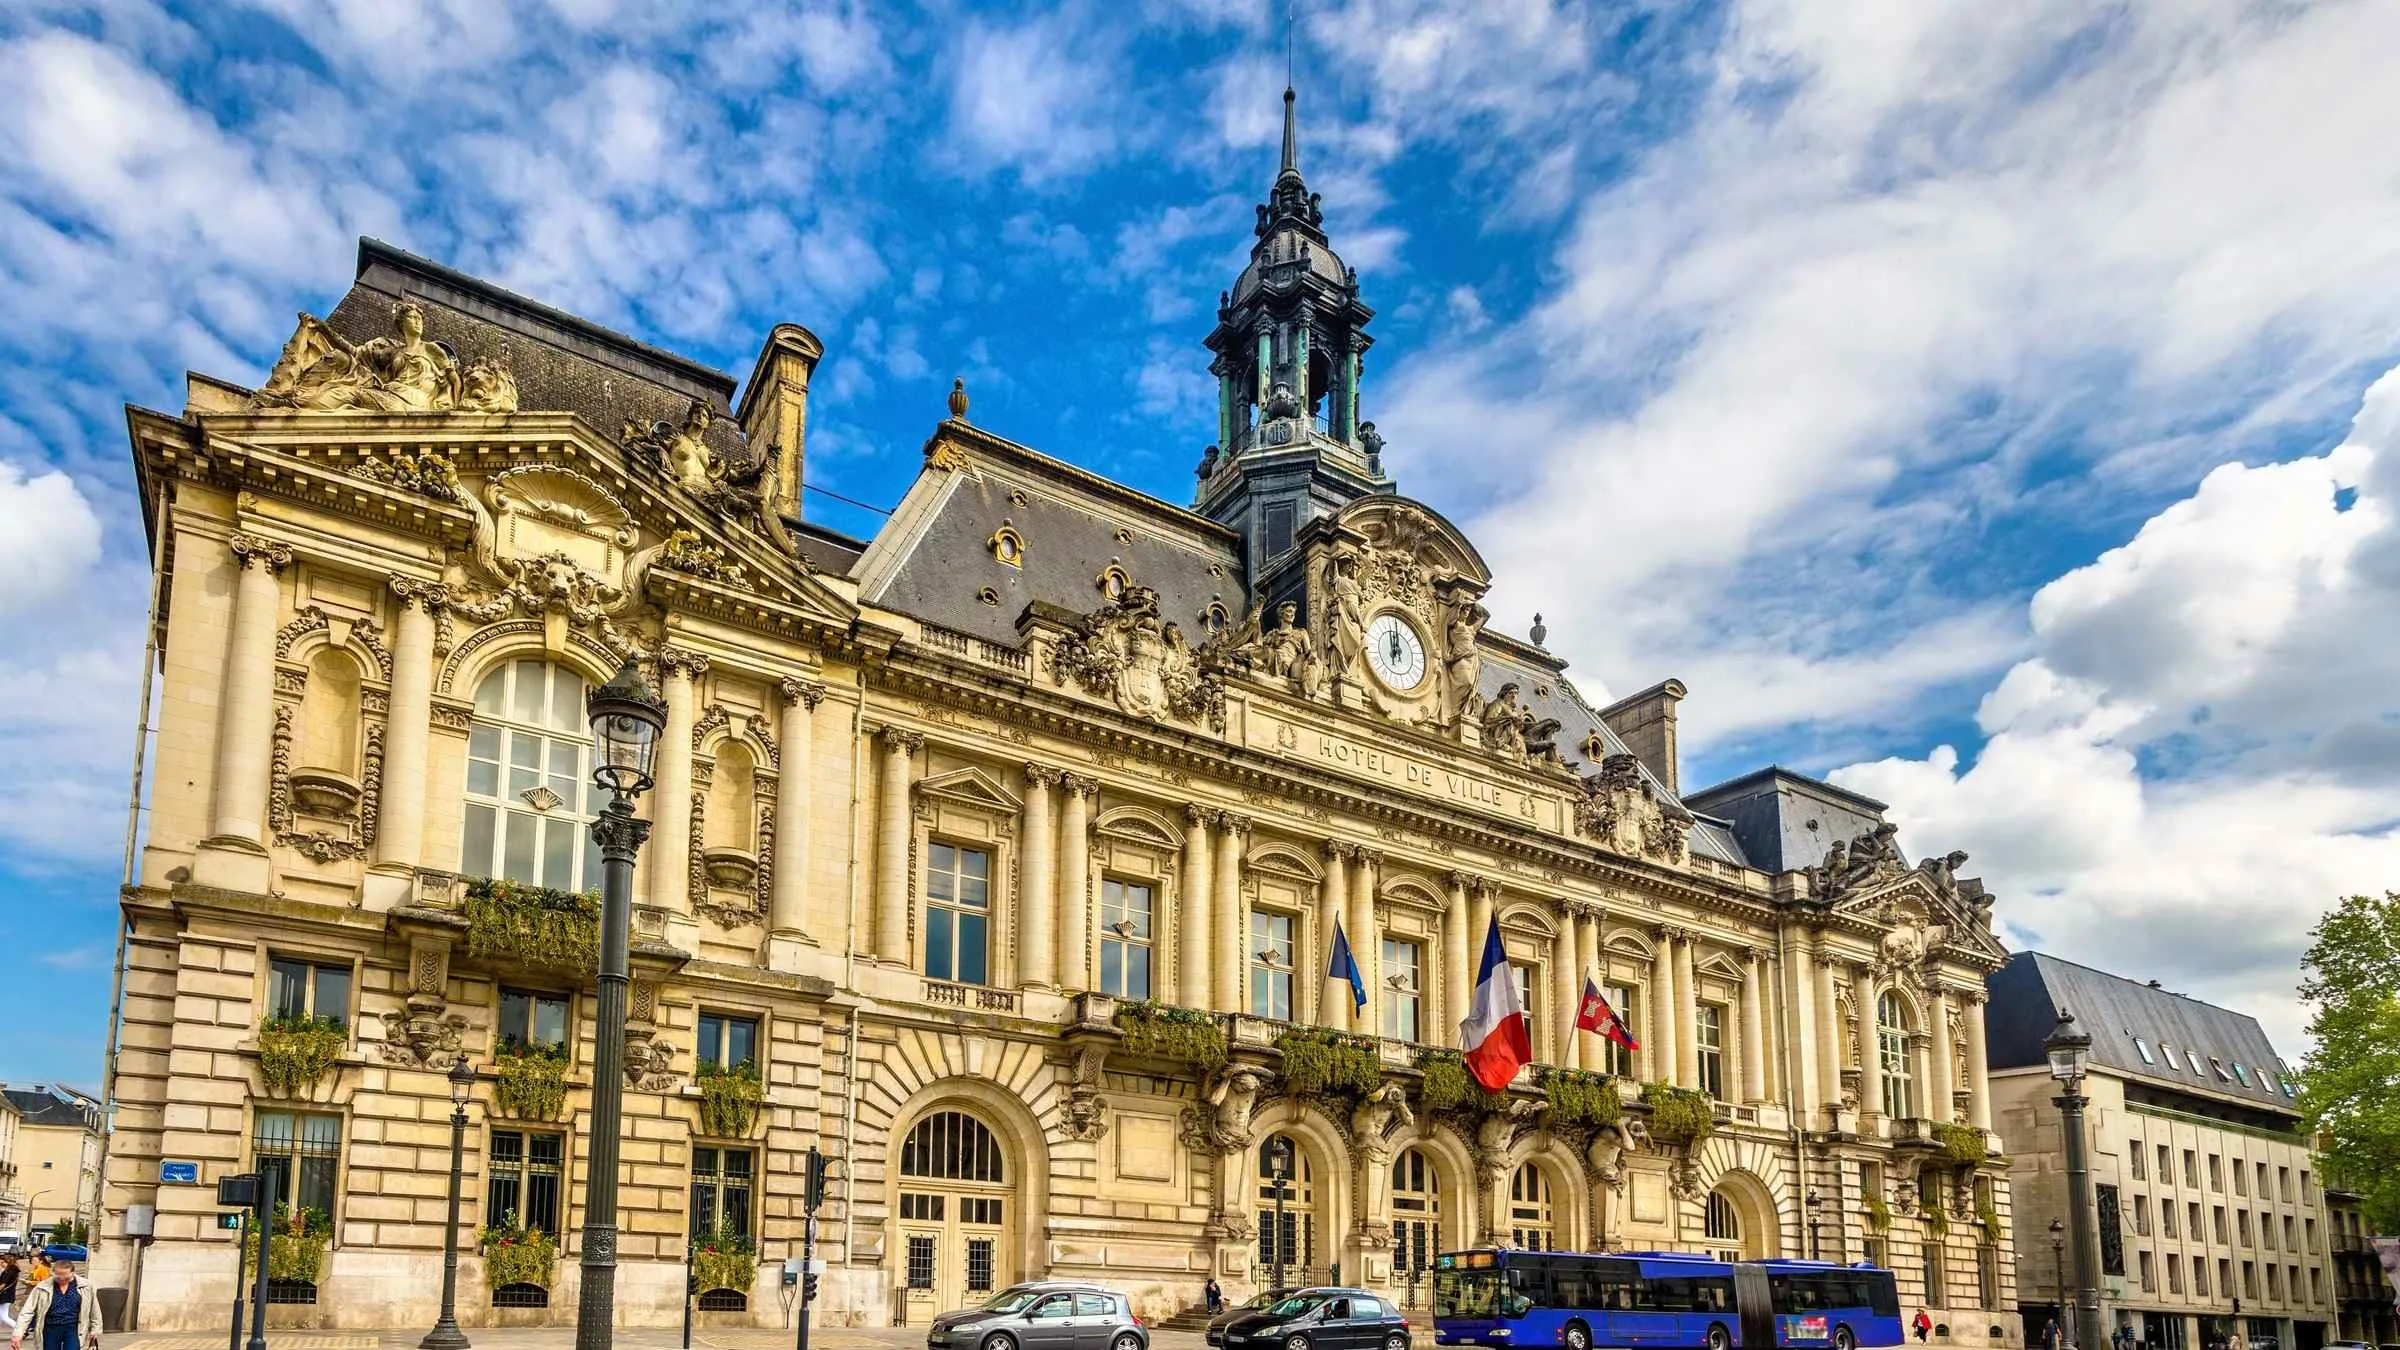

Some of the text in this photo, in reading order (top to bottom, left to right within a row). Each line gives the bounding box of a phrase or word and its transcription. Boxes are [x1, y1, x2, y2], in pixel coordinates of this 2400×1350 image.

[1319, 736, 1502, 806] HOTEL DE VILLE
